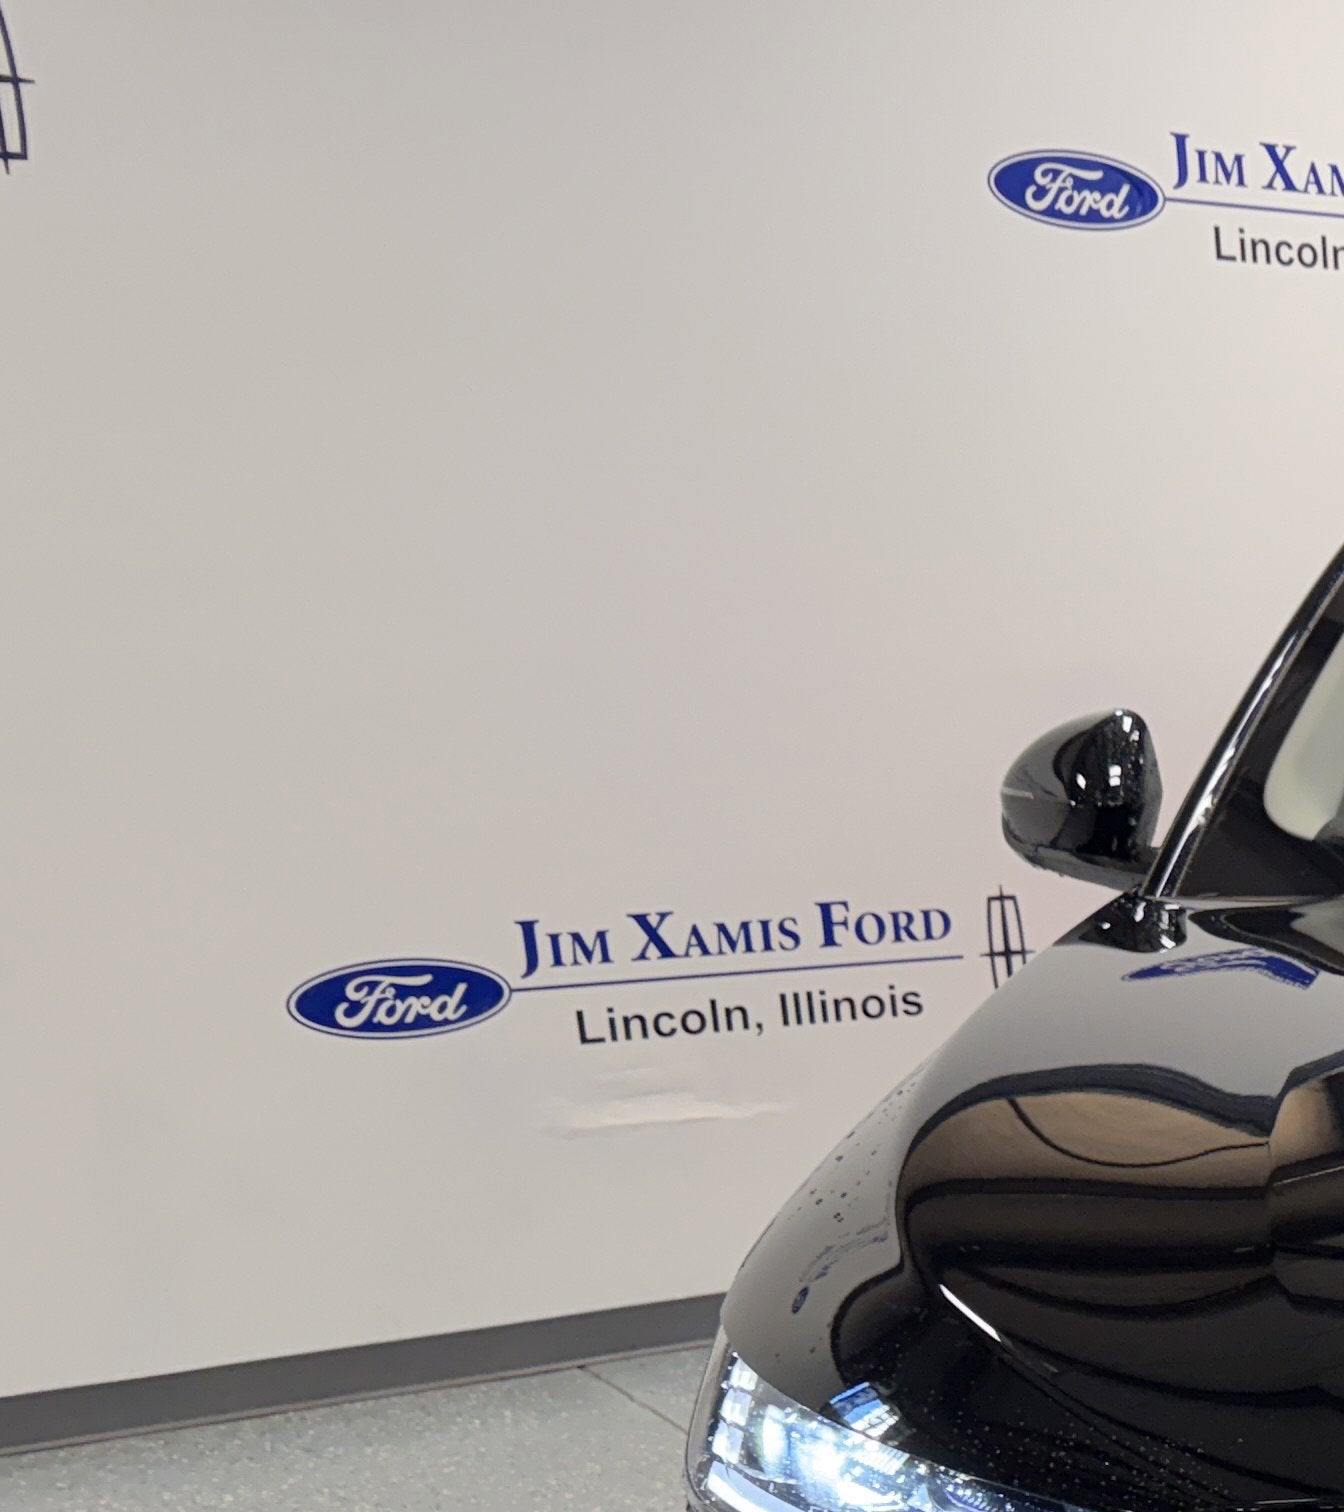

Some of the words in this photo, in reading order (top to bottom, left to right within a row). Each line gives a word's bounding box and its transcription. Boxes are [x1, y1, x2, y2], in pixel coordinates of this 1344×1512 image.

[1169, 132, 1247, 190] JIM
[1024, 161, 1130, 221] Ford
[515, 920, 613, 979] JIM
[627, 912, 800, 961] XAMIS
[815, 901, 951, 948] FORD
[334, 973, 468, 1028] Ford
[576, 999, 763, 1044] Lincoln,
[779, 985, 923, 1026] Illinois
